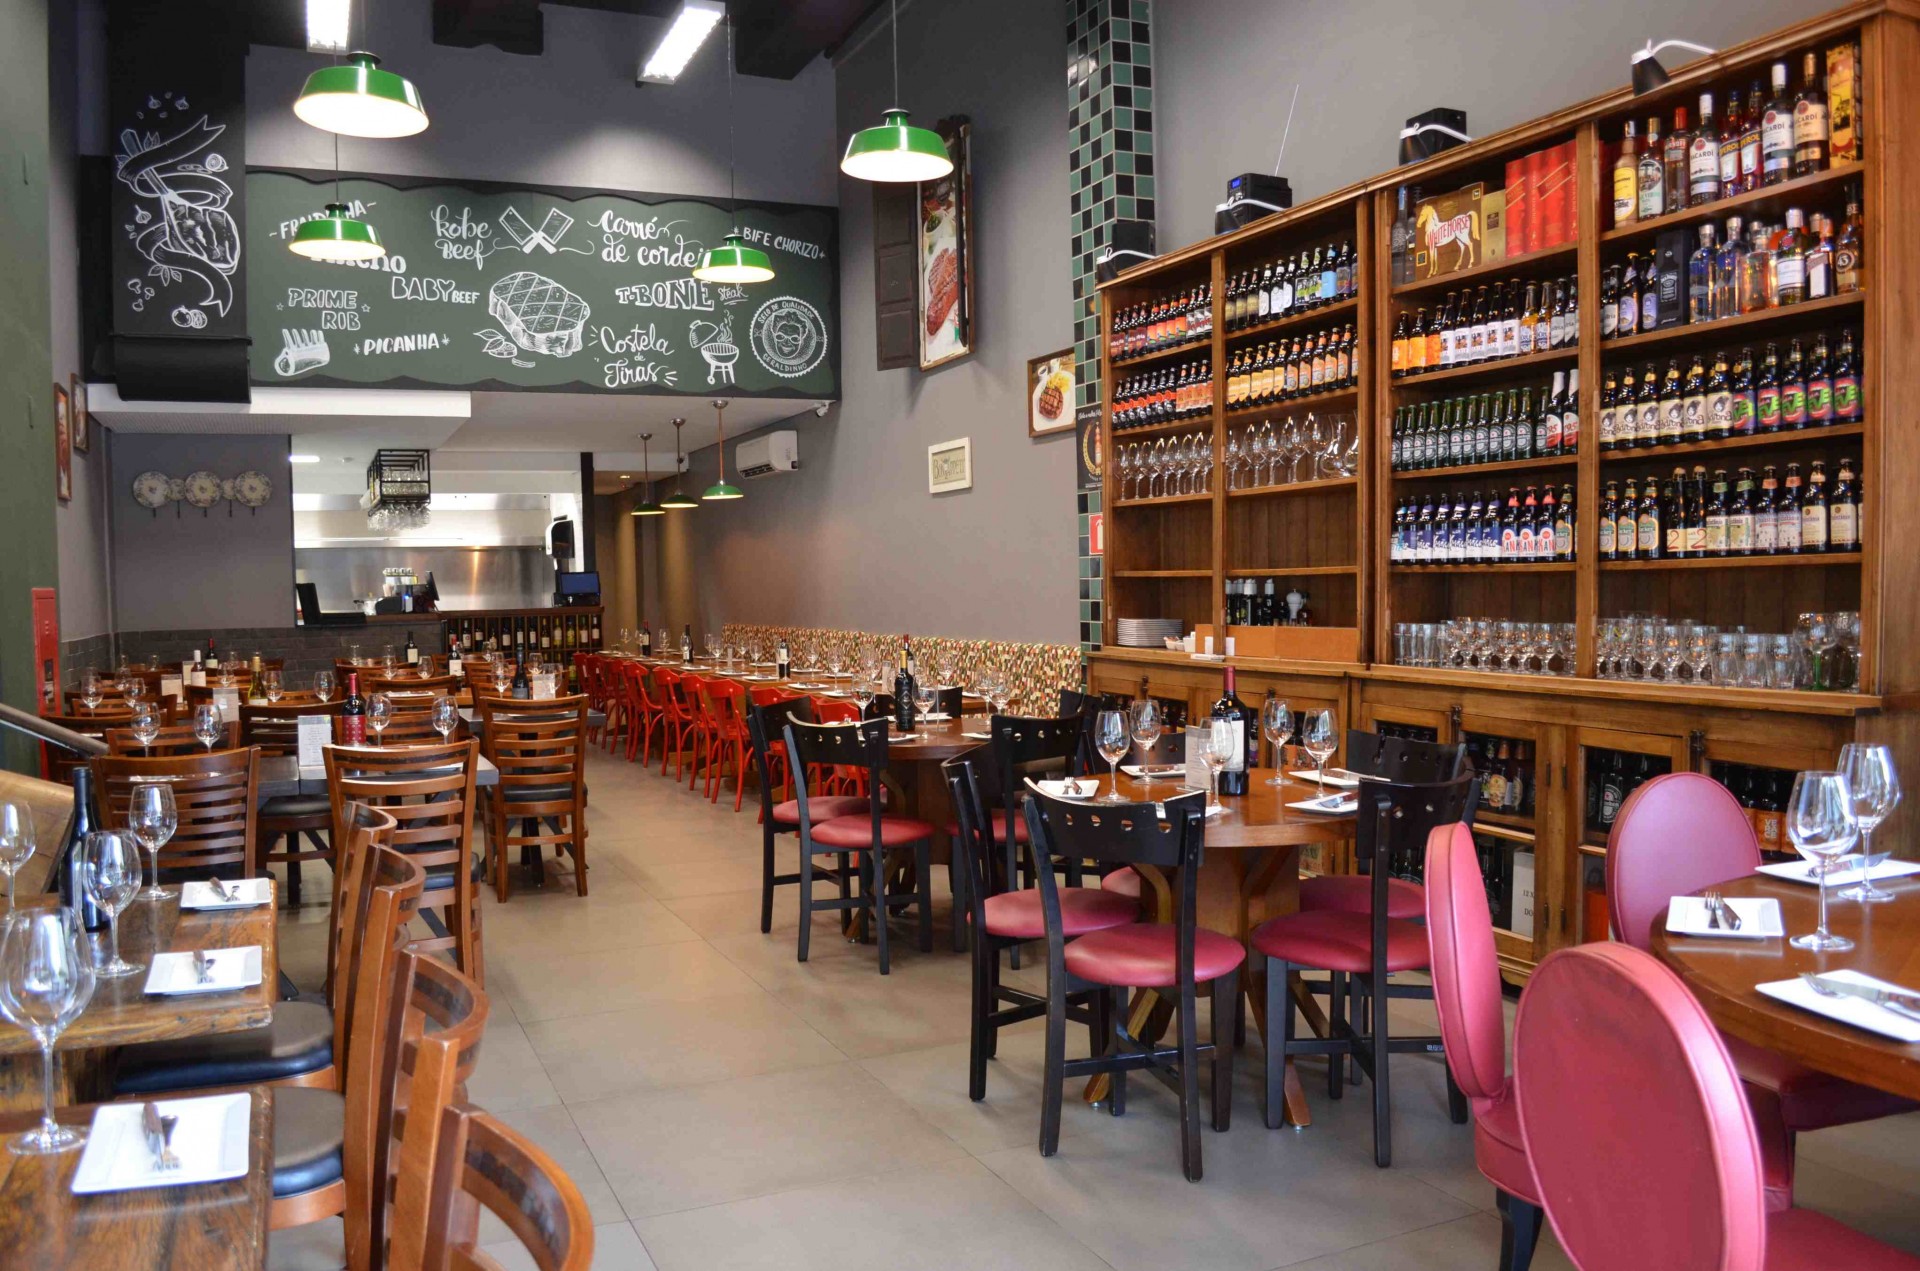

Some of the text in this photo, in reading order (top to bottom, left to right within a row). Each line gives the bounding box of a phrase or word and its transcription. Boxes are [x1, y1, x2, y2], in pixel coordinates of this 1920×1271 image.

[743, 226, 820, 260] BIFE CHORIZO
[1428, 215, 1470, 251] WHITE HORSE
[601, 234, 631, 263] de
[288, 288, 358, 310] PRIME
[391, 276, 480, 304] BABY BEEF
[615, 277, 715, 311] T-BONE
[322, 311, 361, 331] RIB
[363, 333, 440, 356] PICANHA
[600, 323, 675, 355] Costela
[634, 352, 646, 362] de
[604, 358, 664, 388] Tiras
